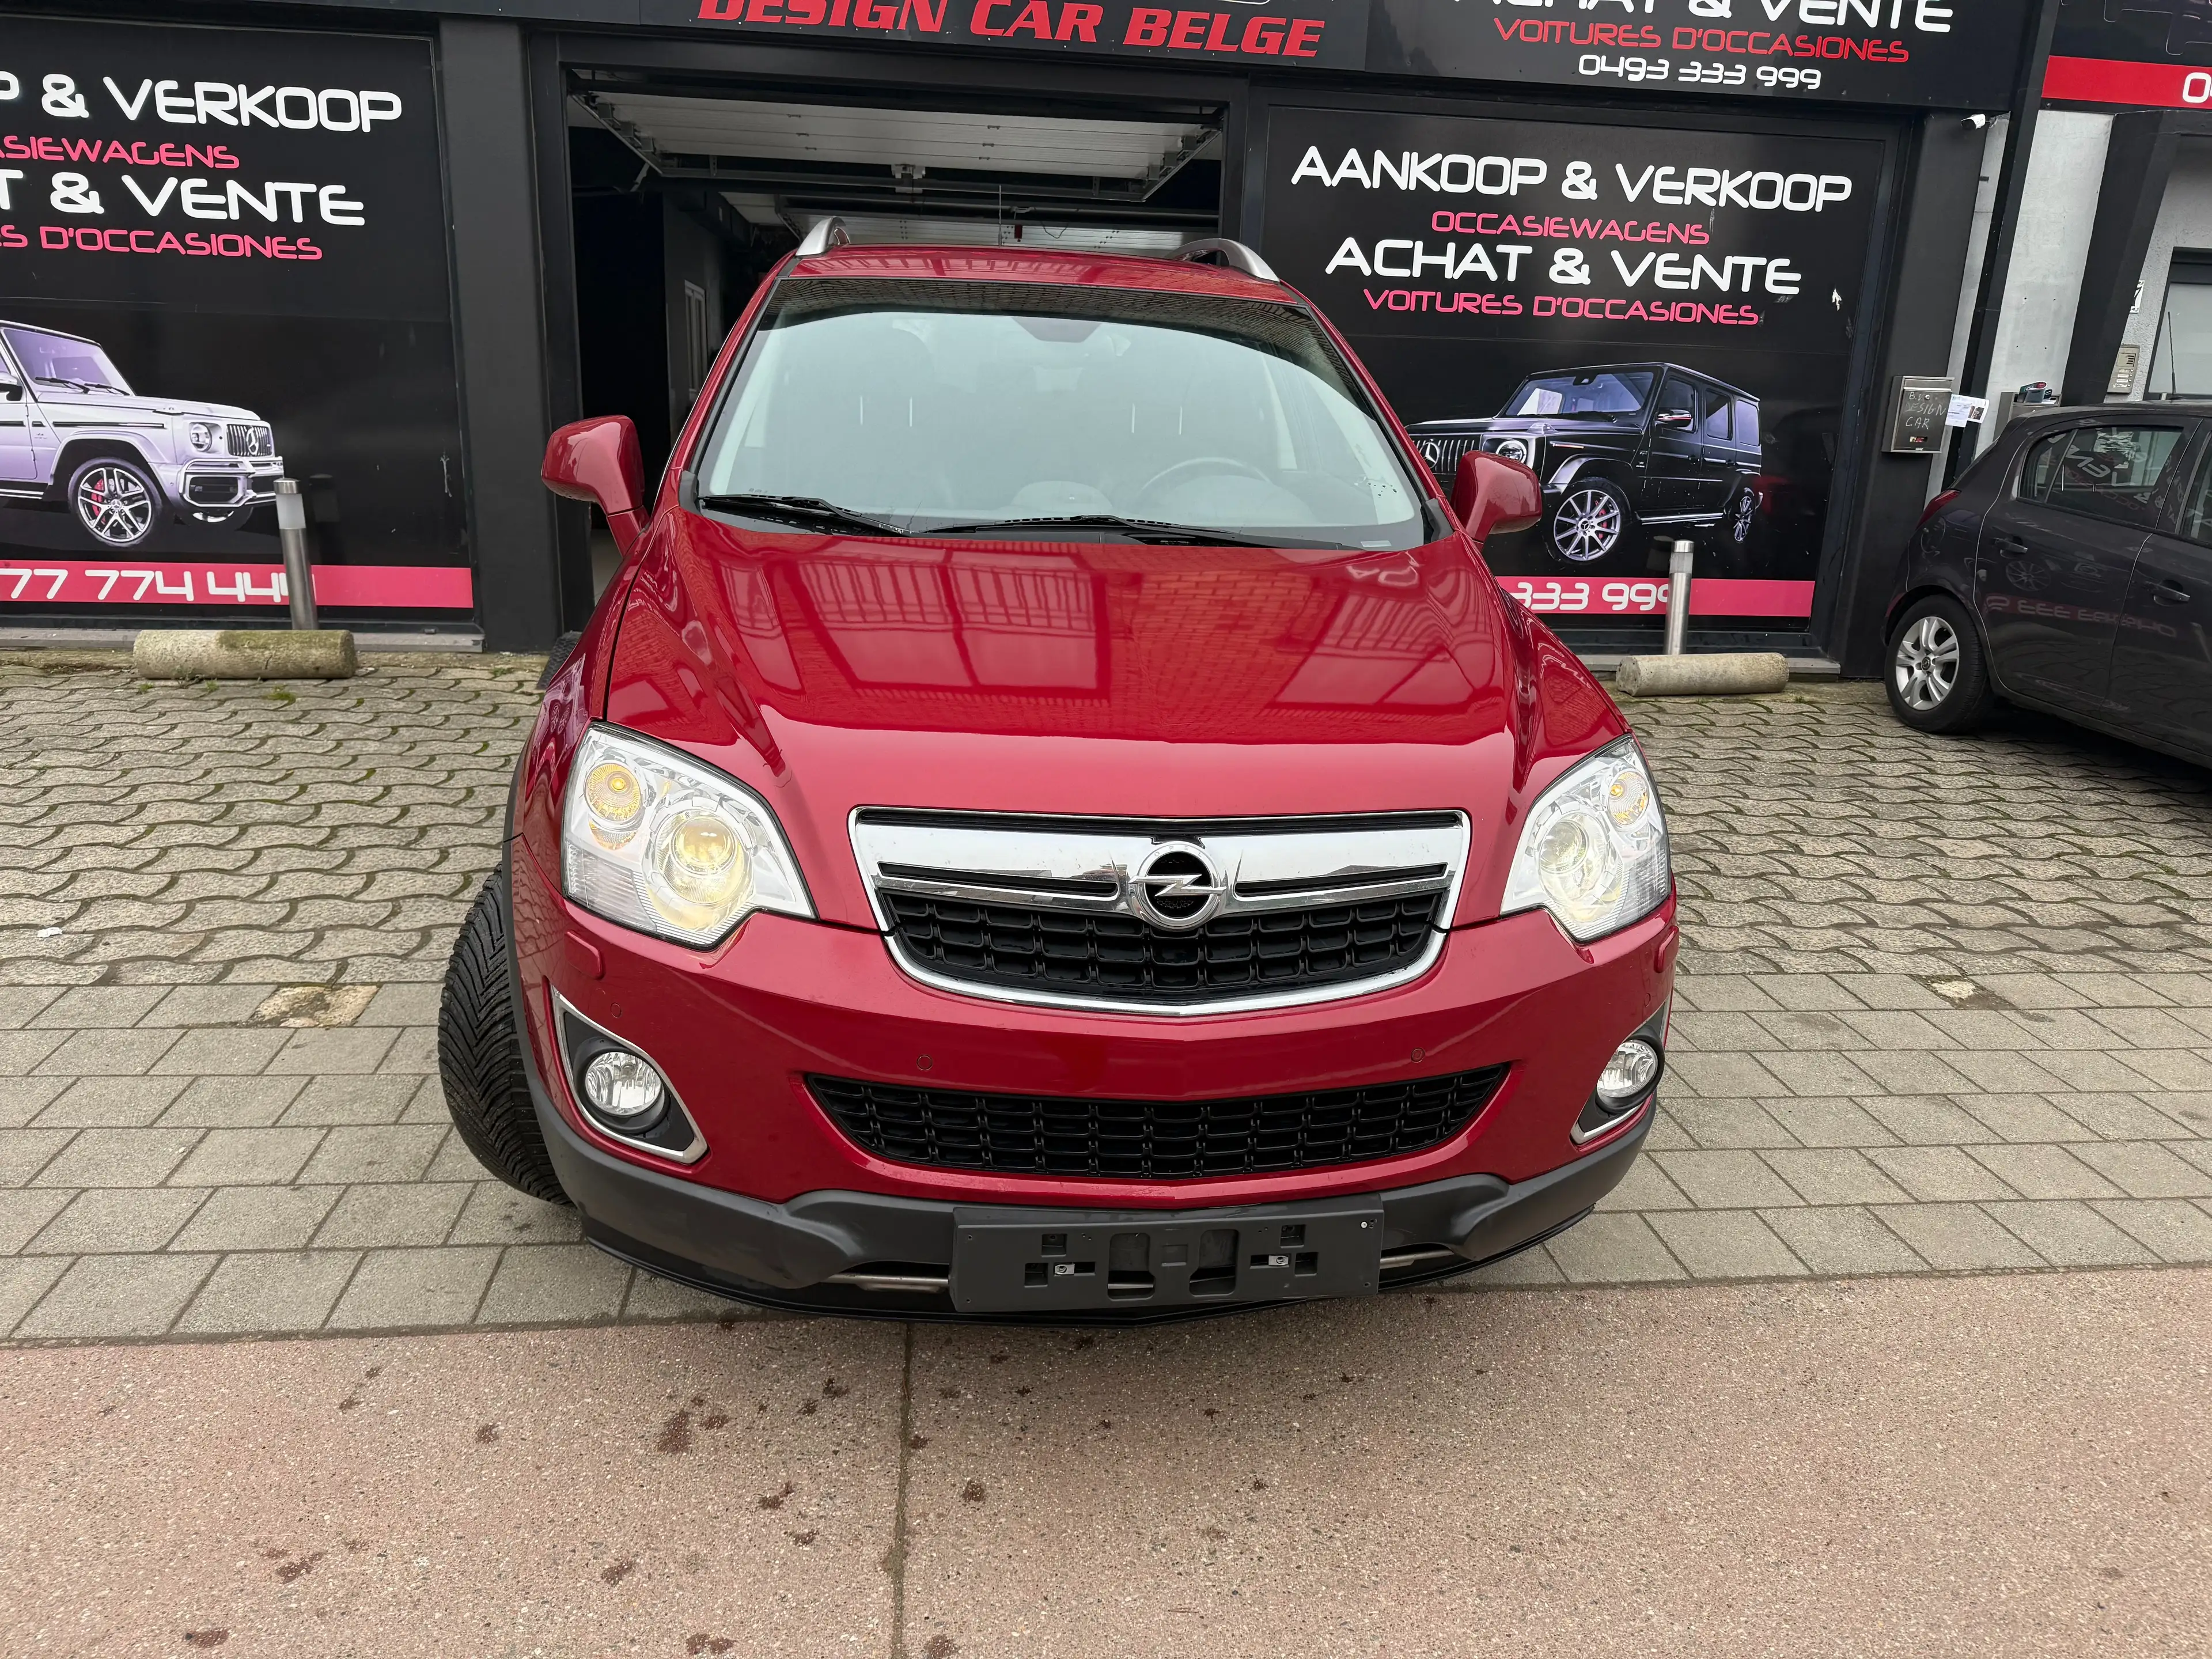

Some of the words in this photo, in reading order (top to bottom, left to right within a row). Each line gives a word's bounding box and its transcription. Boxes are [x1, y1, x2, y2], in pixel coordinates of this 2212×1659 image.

[971, 0, 1104, 43] CAR
[1123, 7, 1325, 57] BELGE
[1760, 0, 1953, 33] VENTE
[1494, 18, 1661, 48] VOITURES
[1672, 27, 1909, 63] D'OCCASIONES
[1578, 54, 1670, 82] 0493
[1677, 61, 1747, 85] 333
[1756, 66, 1821, 89] 999
[41, 74, 89, 118] &
[103, 76, 402, 132] VERKOOP
[0, 135, 240, 169] SIEWAGENS
[1291, 146, 1547, 196] AANKOOP
[1561, 161, 1598, 200] &
[1615, 163, 1852, 212] VERKOOP
[50, 172, 105, 214] &
[121, 175, 365, 226] VENTE
[0, 225, 28, 248] S
[39, 226, 323, 260] D'OCCASIONES
[1431, 211, 1710, 245] OCCASIEWAGENS
[1325, 237, 1533, 282] ACHAT
[1548, 248, 1591, 285] &
[1610, 249, 1802, 295] VENTE
[1364, 289, 1523, 315] VOITURES
[1533, 296, 1759, 325] D'OCCASIONES
[1905, 403, 1946, 415] DESIGN
[1906, 416, 1929, 430] CAR
[85, 569, 194, 602] 774
[207, 571, 316, 603] 44
[1154, 845, 1203, 858] OPEL
